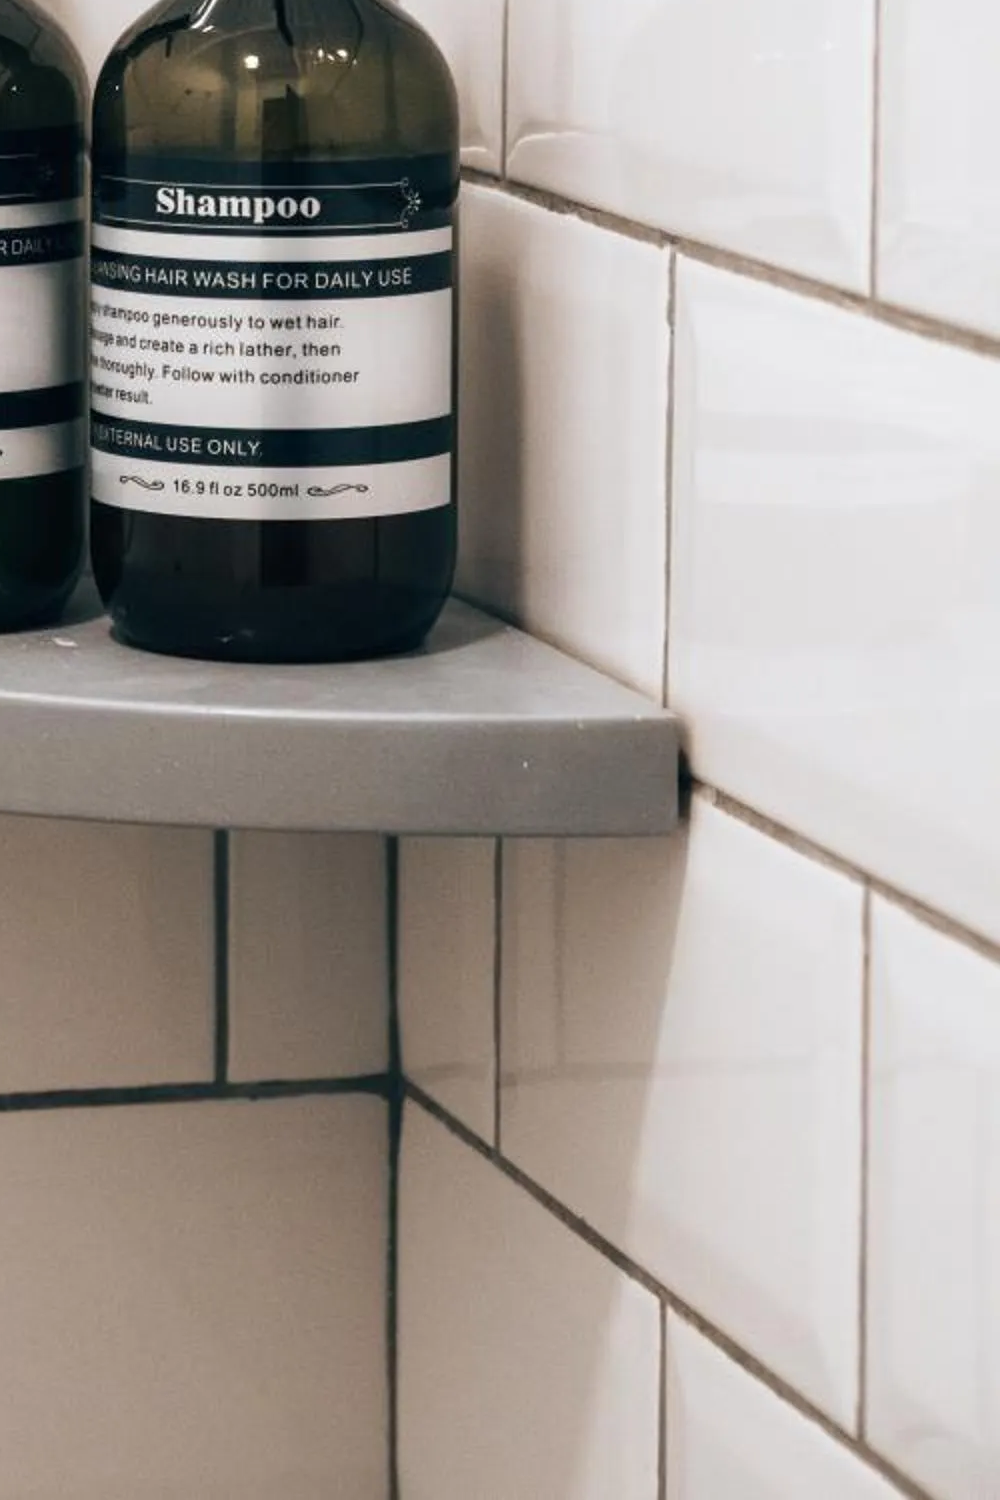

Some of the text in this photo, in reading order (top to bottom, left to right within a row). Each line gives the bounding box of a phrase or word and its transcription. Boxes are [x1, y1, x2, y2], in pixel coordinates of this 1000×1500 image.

[156, 187, 321, 224] Shampoo
[145, 267, 188, 285] HAIR
[193, 272, 256, 289] WASH
[262, 273, 308, 289] FOR
[315, 270, 373, 289] DAILY
[378, 268, 412, 286] USE
[153, 312, 242, 332] generously
[248, 314, 265, 330] to
[270, 314, 302, 330] wet
[116, 335, 137, 348] and
[139, 338, 185, 354] create
[189, 342, 197, 355] a
[203, 340, 235, 356] rich
[240, 340, 297, 360] lather,
[302, 340, 341, 356] then
[162, 364, 214, 383] Follow
[219, 367, 255, 384] with
[260, 367, 360, 384] conditioner
[166, 435, 201, 453] USE
[173, 479, 300, 497] 16.9 fl oz 500ml
